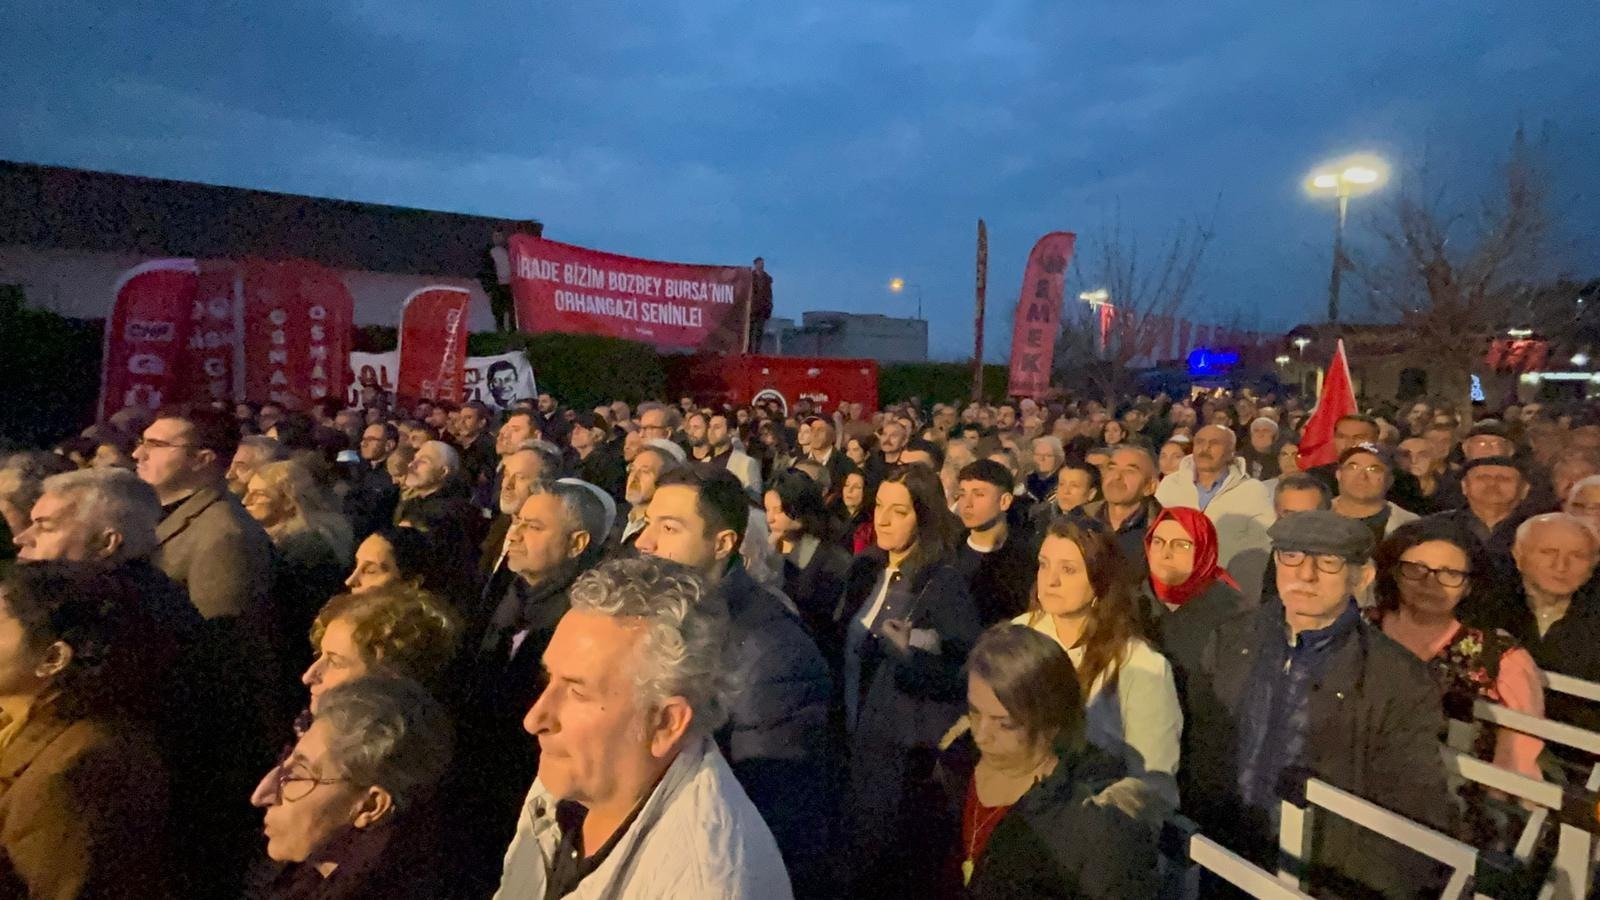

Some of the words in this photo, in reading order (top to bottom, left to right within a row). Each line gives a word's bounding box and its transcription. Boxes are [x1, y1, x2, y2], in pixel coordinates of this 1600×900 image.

[518, 256, 560, 283] İRADE
[564, 262, 605, 287] BİZİM
[609, 270, 663, 295] BOZBEY
[665, 278, 735, 304] BURSA'NIN
[554, 290, 638, 320] ORHANGAZİ
[642, 302, 702, 328] SENİNLE!
